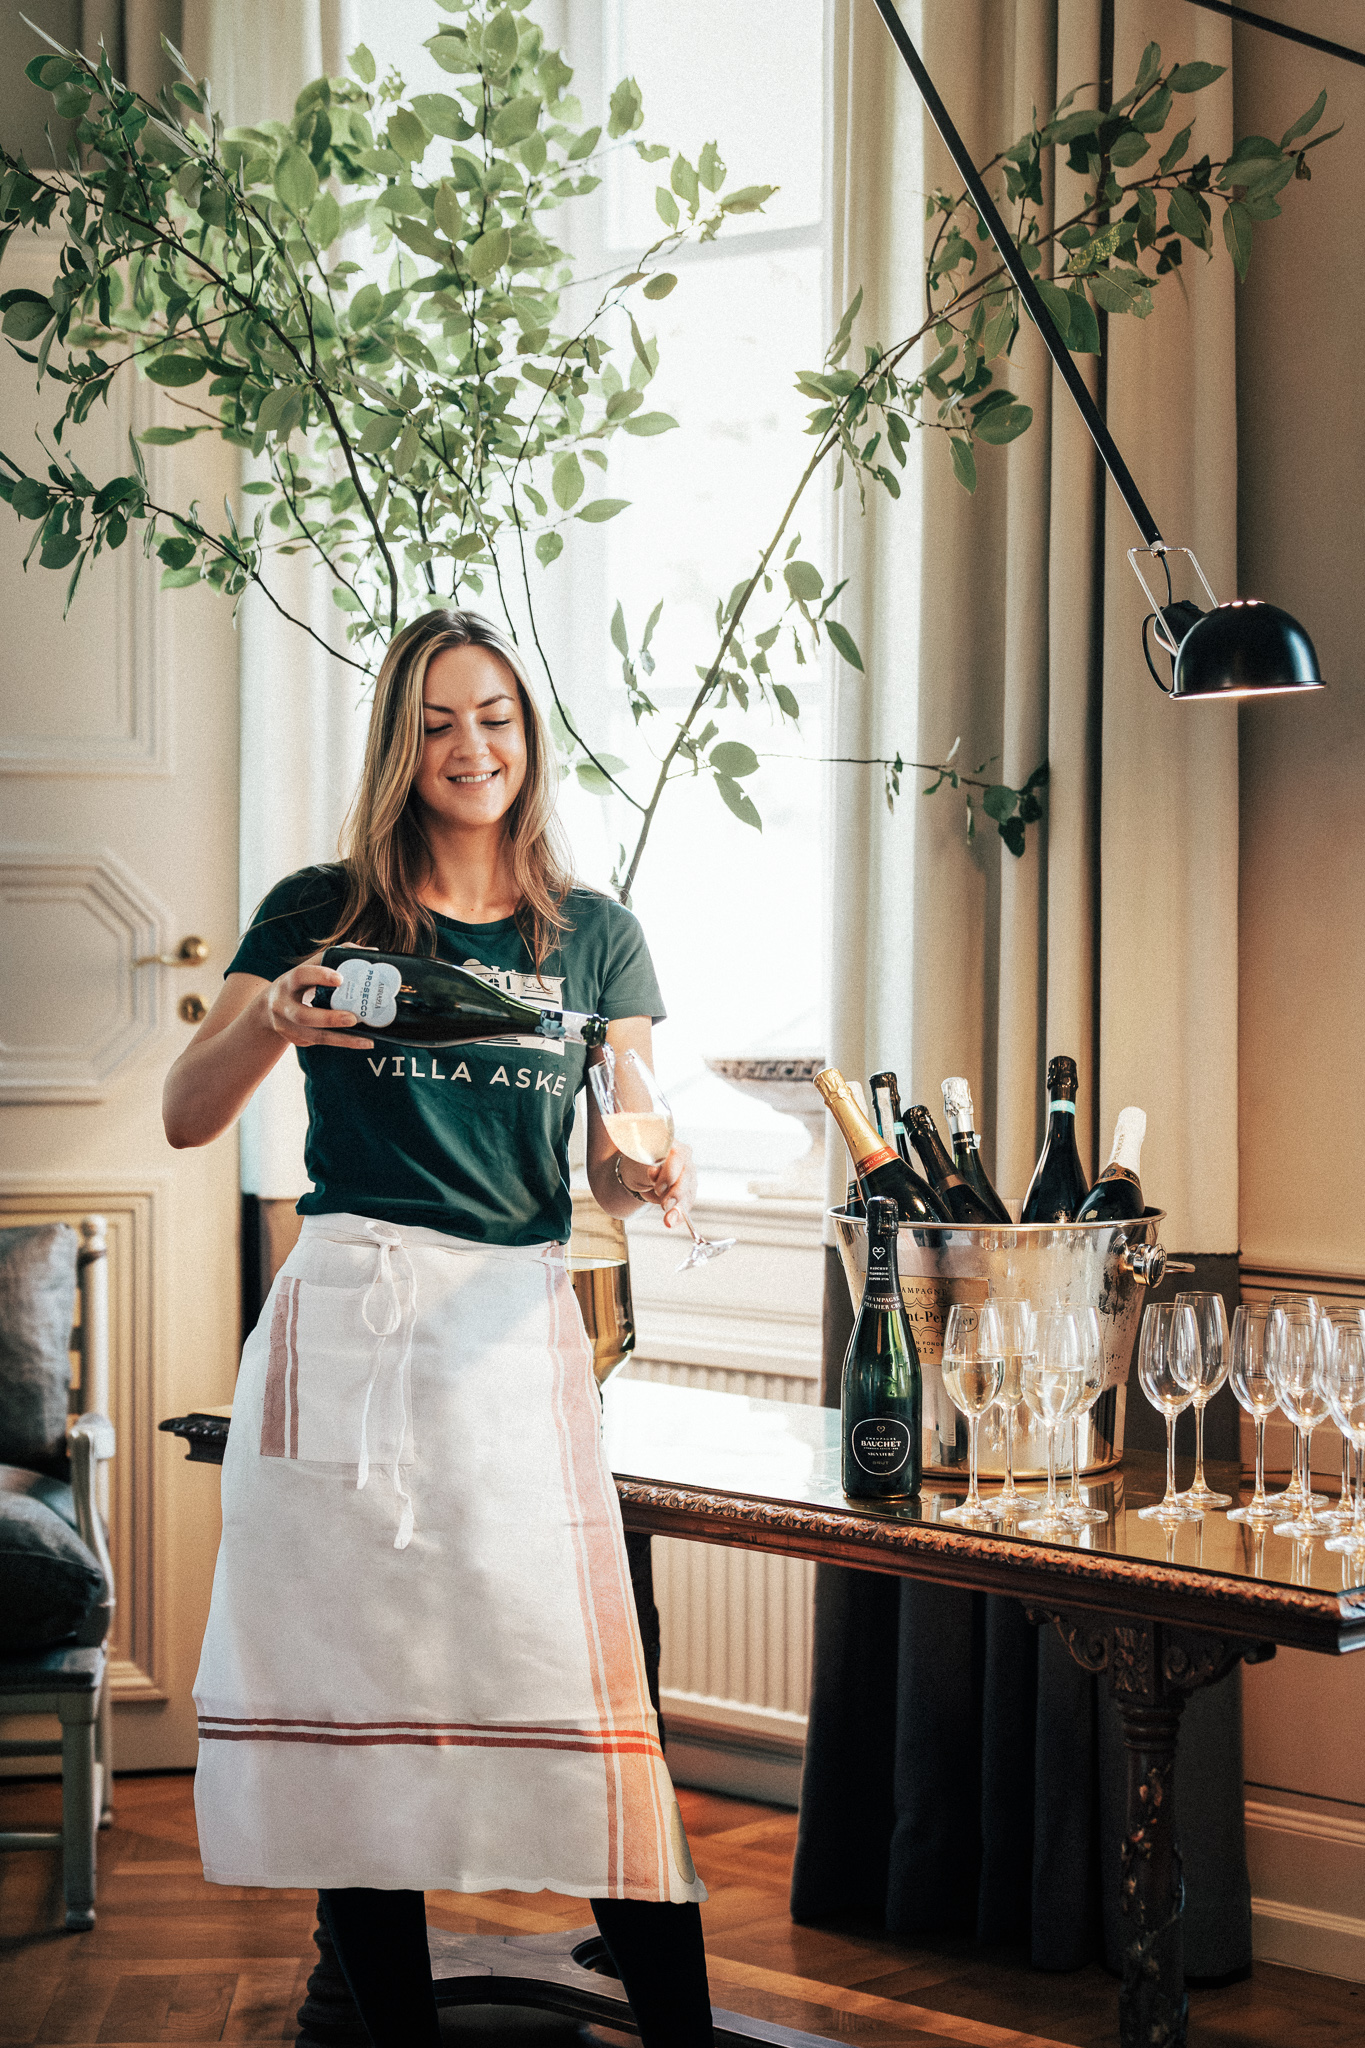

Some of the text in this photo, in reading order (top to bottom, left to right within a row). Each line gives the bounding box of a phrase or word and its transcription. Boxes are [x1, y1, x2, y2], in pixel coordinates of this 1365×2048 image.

[360, 969, 374, 1017] PROSECCO
[367, 1056, 567, 1097] VILLA ASKE
[901, 1287, 947, 1296] AMPAGNE
[865, 1294, 900, 1303] CHAMPAGNE
[864, 1301, 890, 1310] PREMIER
